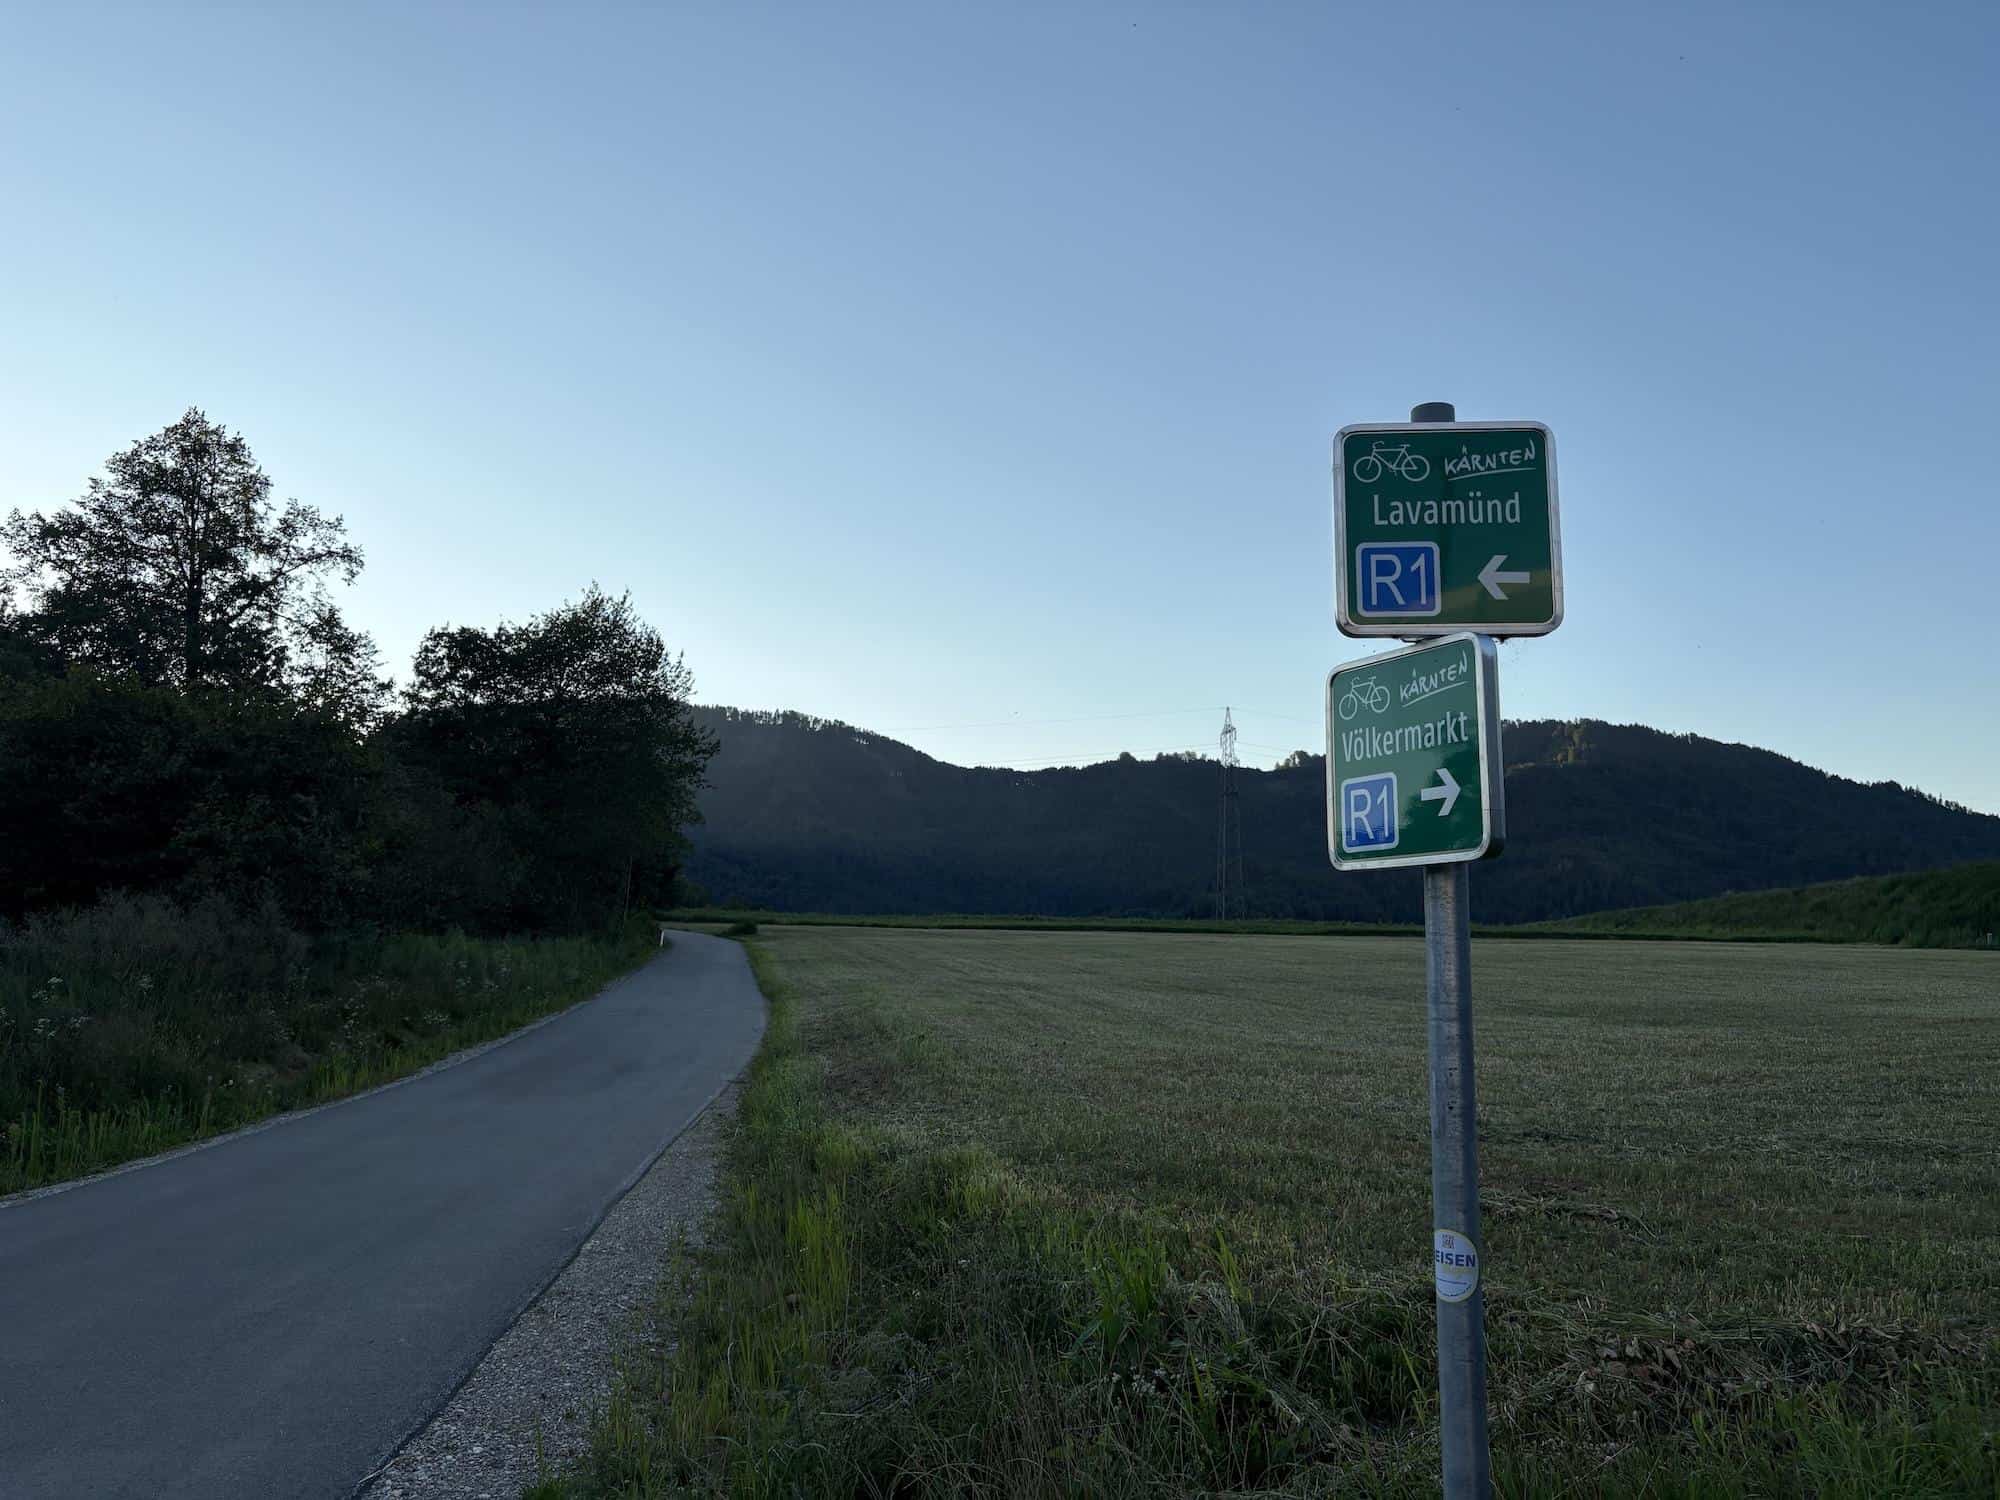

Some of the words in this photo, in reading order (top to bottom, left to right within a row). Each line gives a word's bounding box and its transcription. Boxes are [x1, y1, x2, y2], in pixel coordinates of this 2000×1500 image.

[1373, 491, 1521, 525] Lavamünd
[1369, 553, 1427, 606] R1
[1342, 711, 1469, 762] Völkermarkt
[1350, 784, 1390, 841] R1
